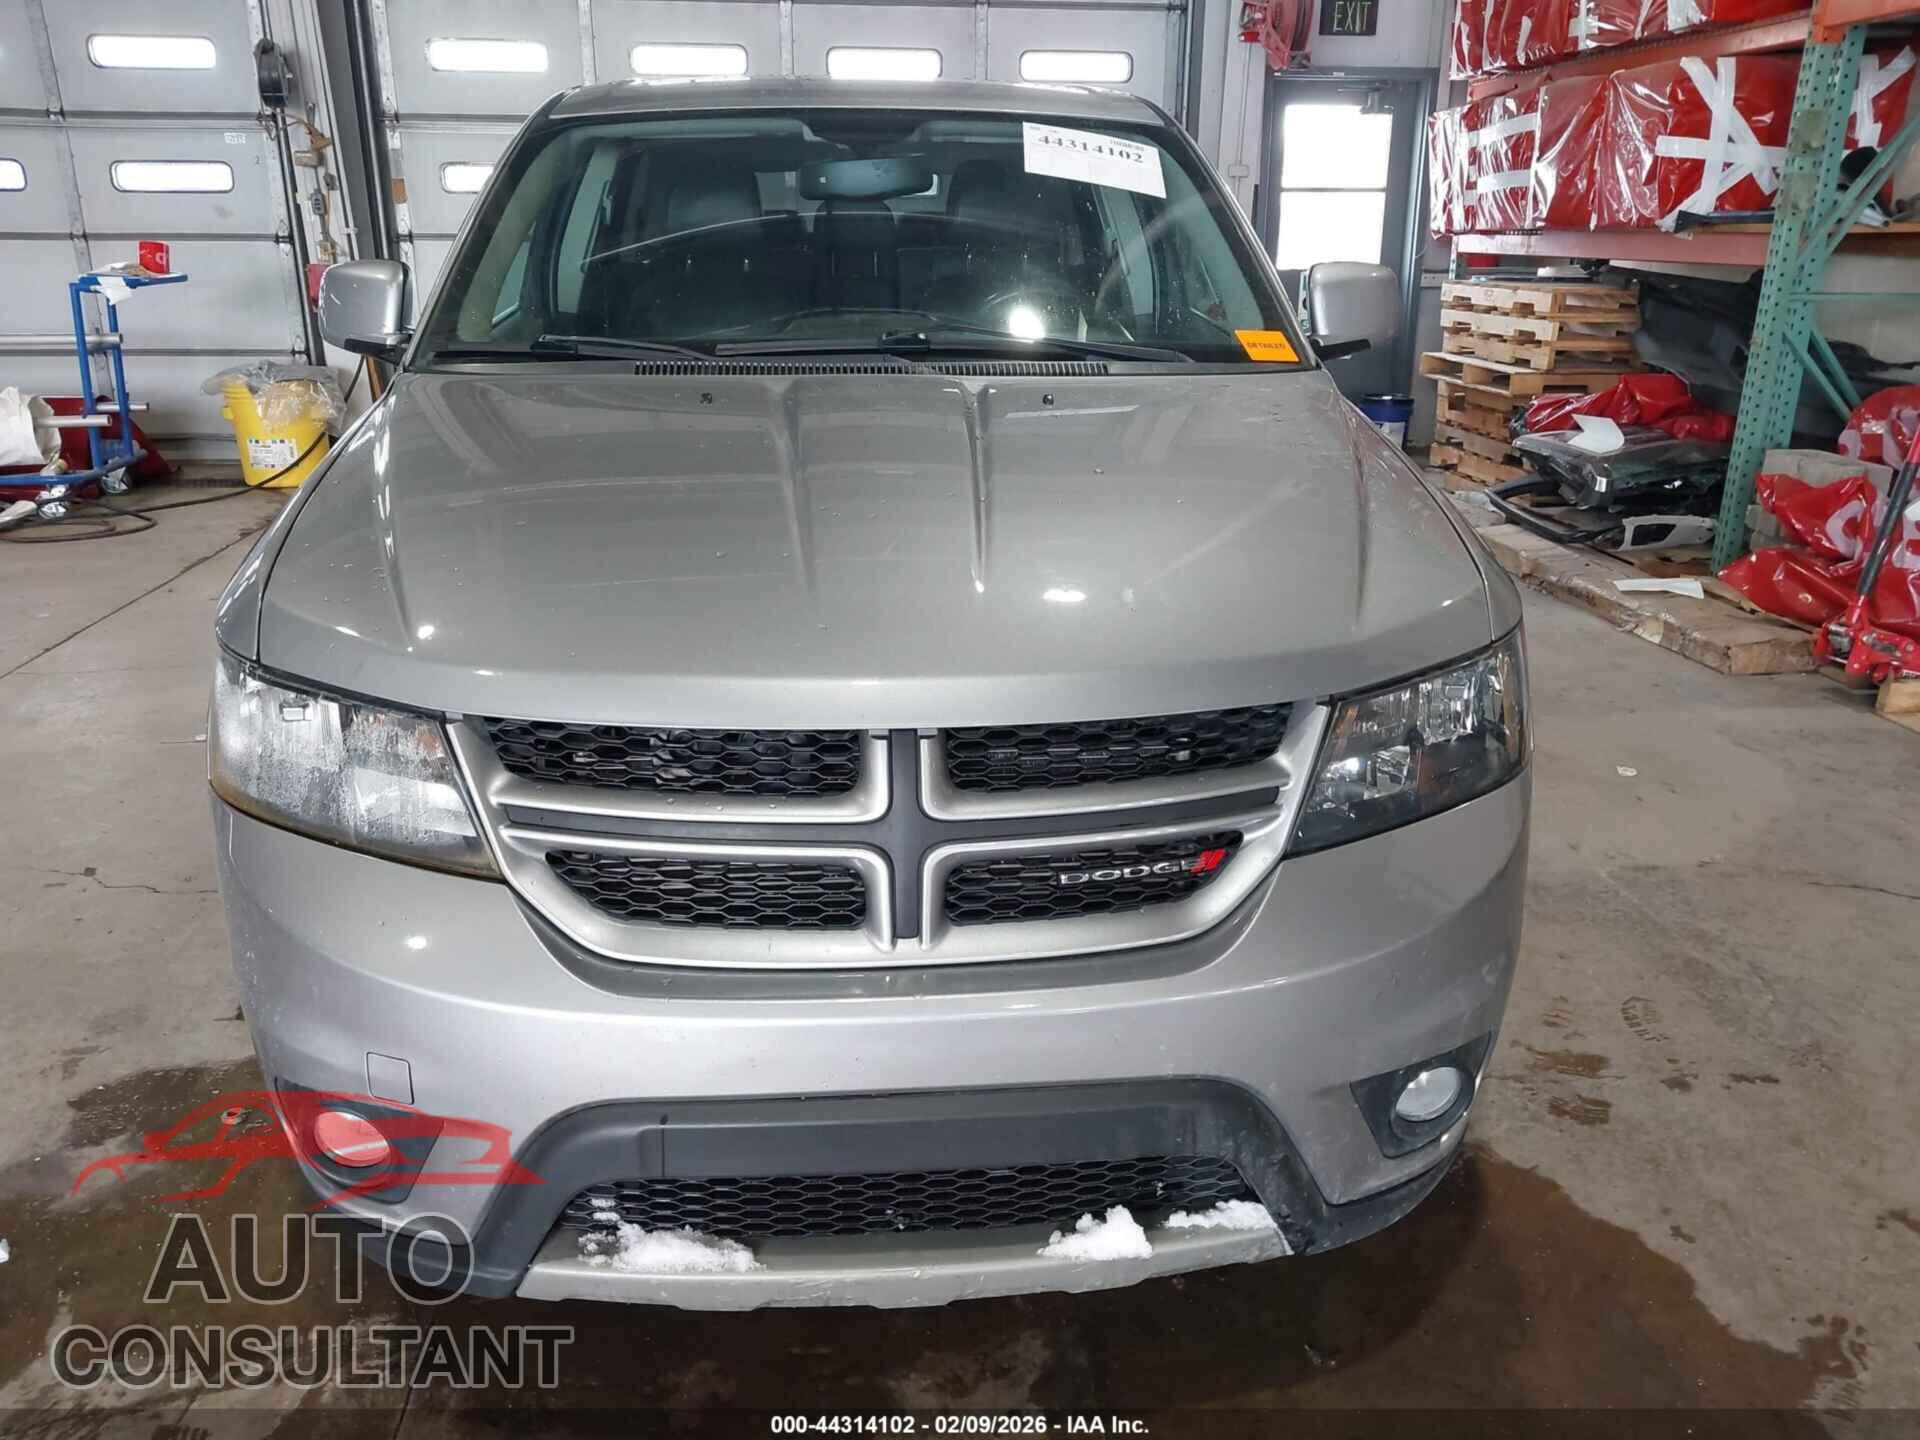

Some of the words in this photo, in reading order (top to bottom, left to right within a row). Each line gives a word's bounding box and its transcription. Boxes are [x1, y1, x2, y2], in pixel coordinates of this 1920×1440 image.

[1333, 1, 1372, 33] EXIT
[1038, 135, 1144, 164] 44314102
[1060, 859, 1199, 884] DODGE
